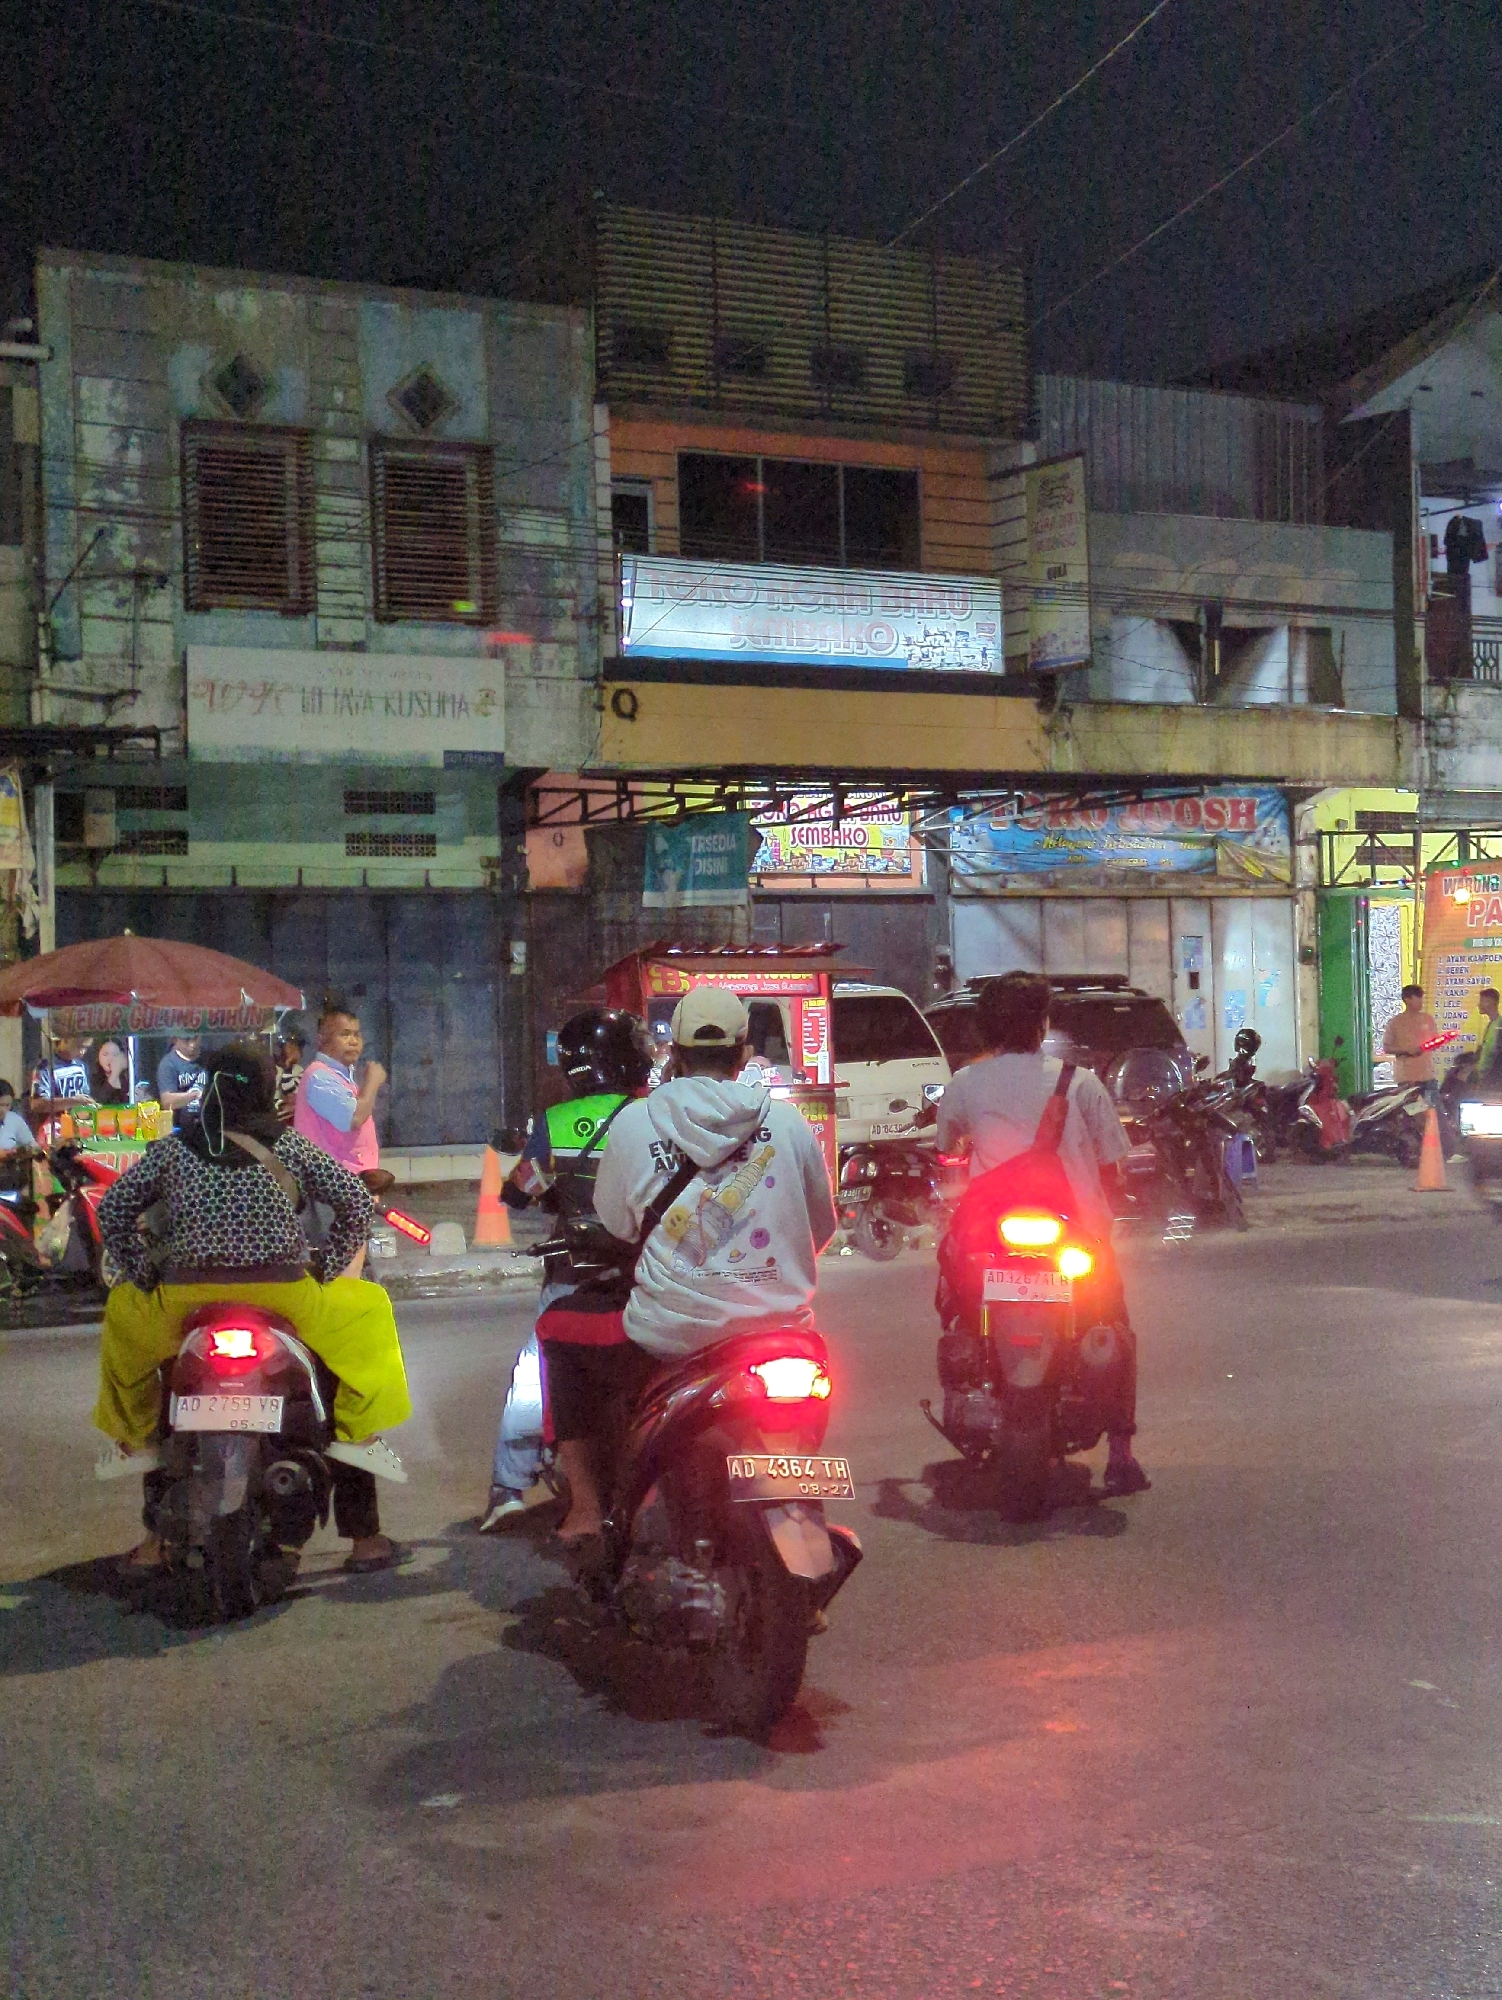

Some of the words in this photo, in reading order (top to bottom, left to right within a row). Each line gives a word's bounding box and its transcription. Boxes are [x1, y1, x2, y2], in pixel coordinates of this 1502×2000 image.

[881, 580, 974, 621] BARU
[730, 614, 900, 657] SEMBAKO
[1117, 797, 1258, 832] JOOSH
[790, 826, 869, 849] SEMBAKO
[1466, 977, 1491, 986] SAYUR
[1444, 1000, 1461, 1008] LELE
[130, 1003, 202, 1032] GULUNG
[1443, 1011, 1468, 1020] UDANG
[180, 1398, 201, 1412] AD
[209, 1397, 251, 1412] 2759
[731, 1459, 755, 1478] AD
[767, 1459, 815, 1478] 4364
[822, 1460, 848, 1479] TH
